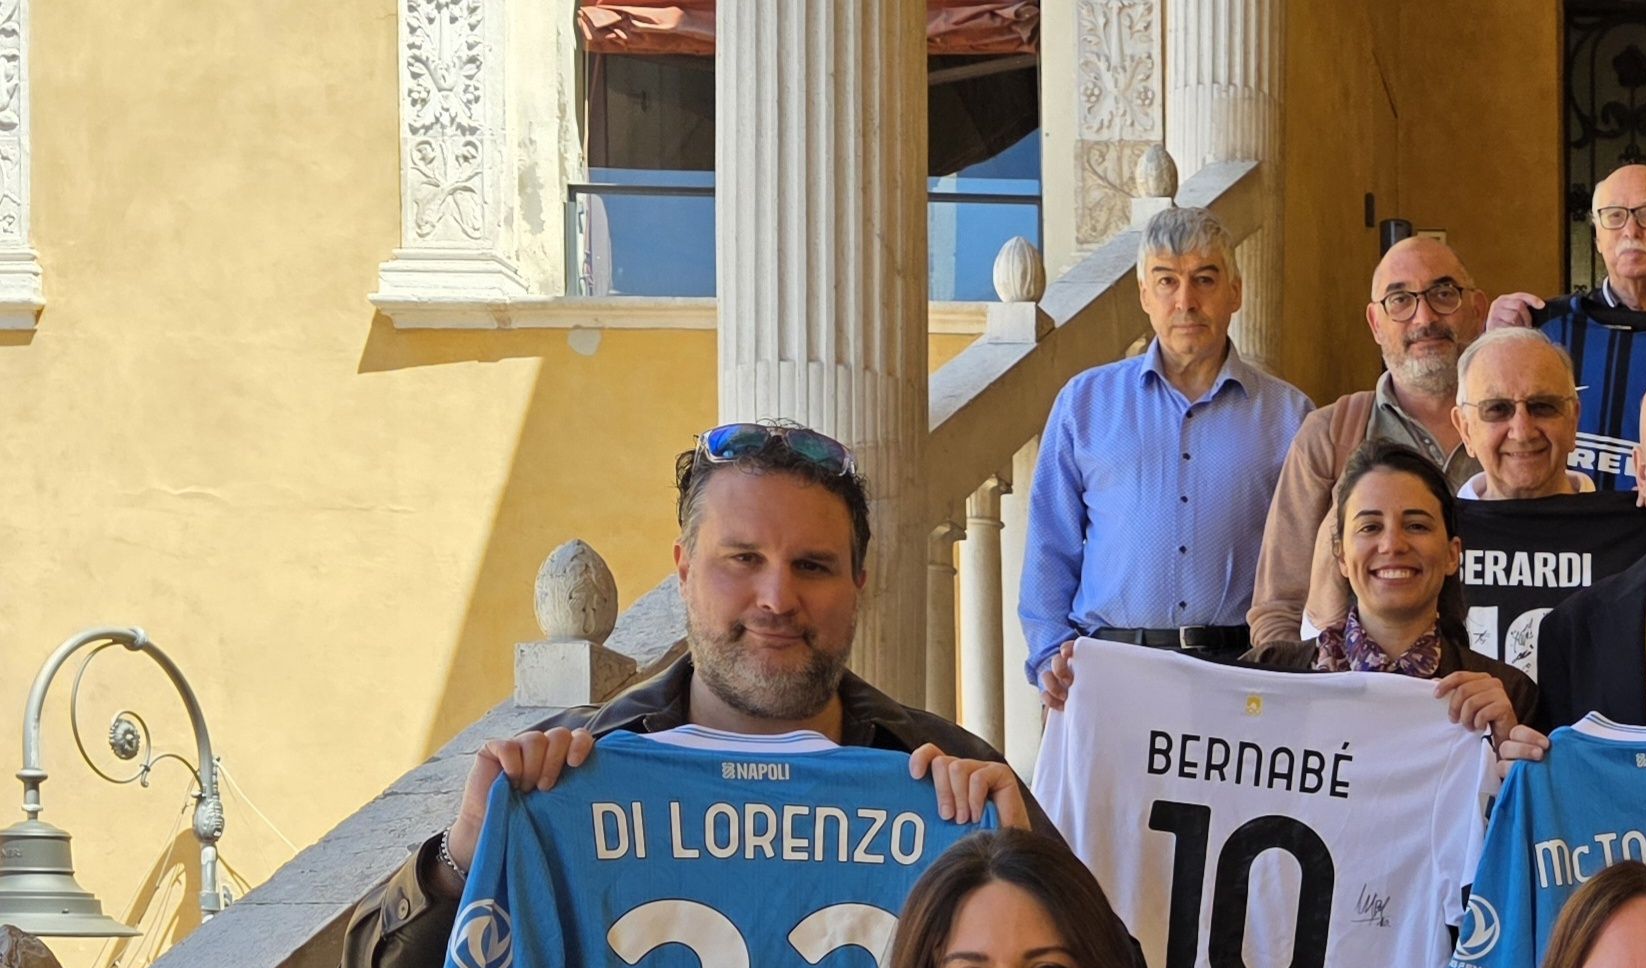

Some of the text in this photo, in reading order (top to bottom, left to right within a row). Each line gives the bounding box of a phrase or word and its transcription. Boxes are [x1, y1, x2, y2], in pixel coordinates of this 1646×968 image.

[736, 762, 790, 780] NAPOLI
[1147, 730, 1354, 799] BERNABÉ
[592, 801, 926, 865] DI LORENZO
